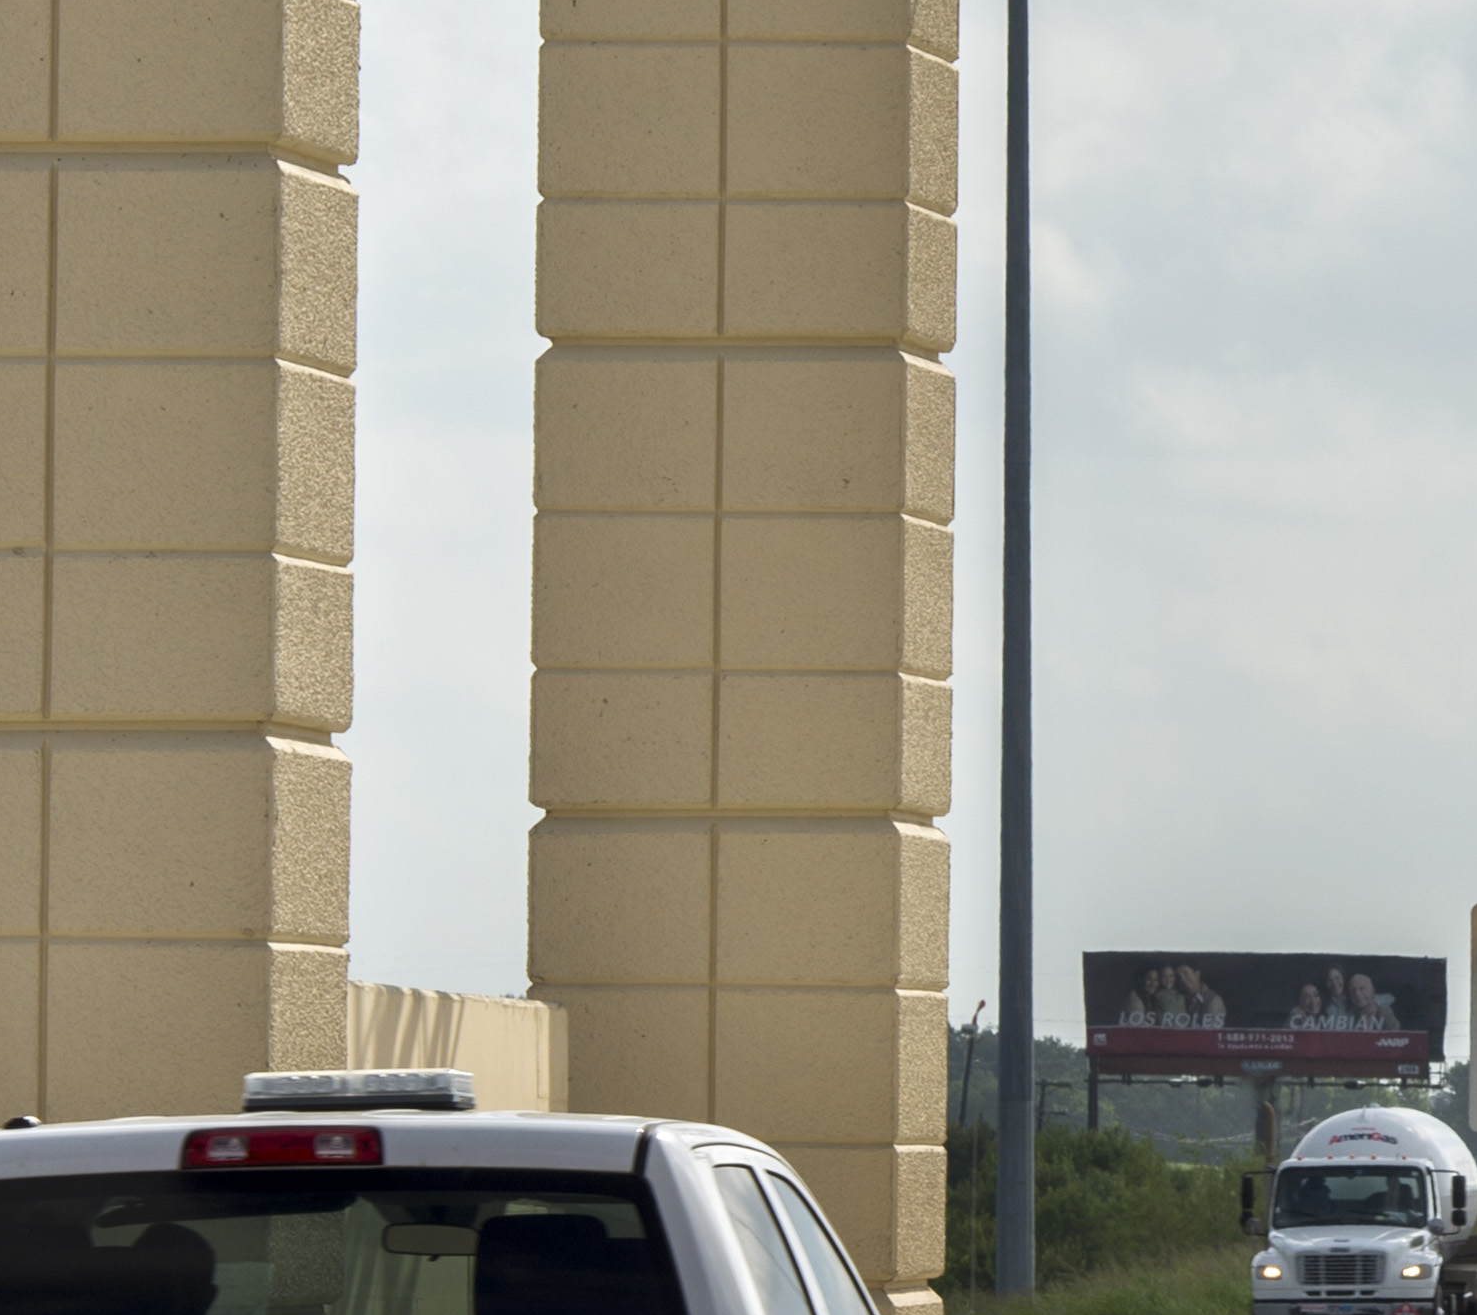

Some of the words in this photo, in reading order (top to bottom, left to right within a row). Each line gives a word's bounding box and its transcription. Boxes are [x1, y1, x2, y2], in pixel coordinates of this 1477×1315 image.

[1118, 1011, 1157, 1028] LOS
[1161, 1011, 1226, 1029] ROLES
[1289, 1014, 1385, 1031] CAMBIAN
[1327, 1132, 1399, 1145] AmeriGas
